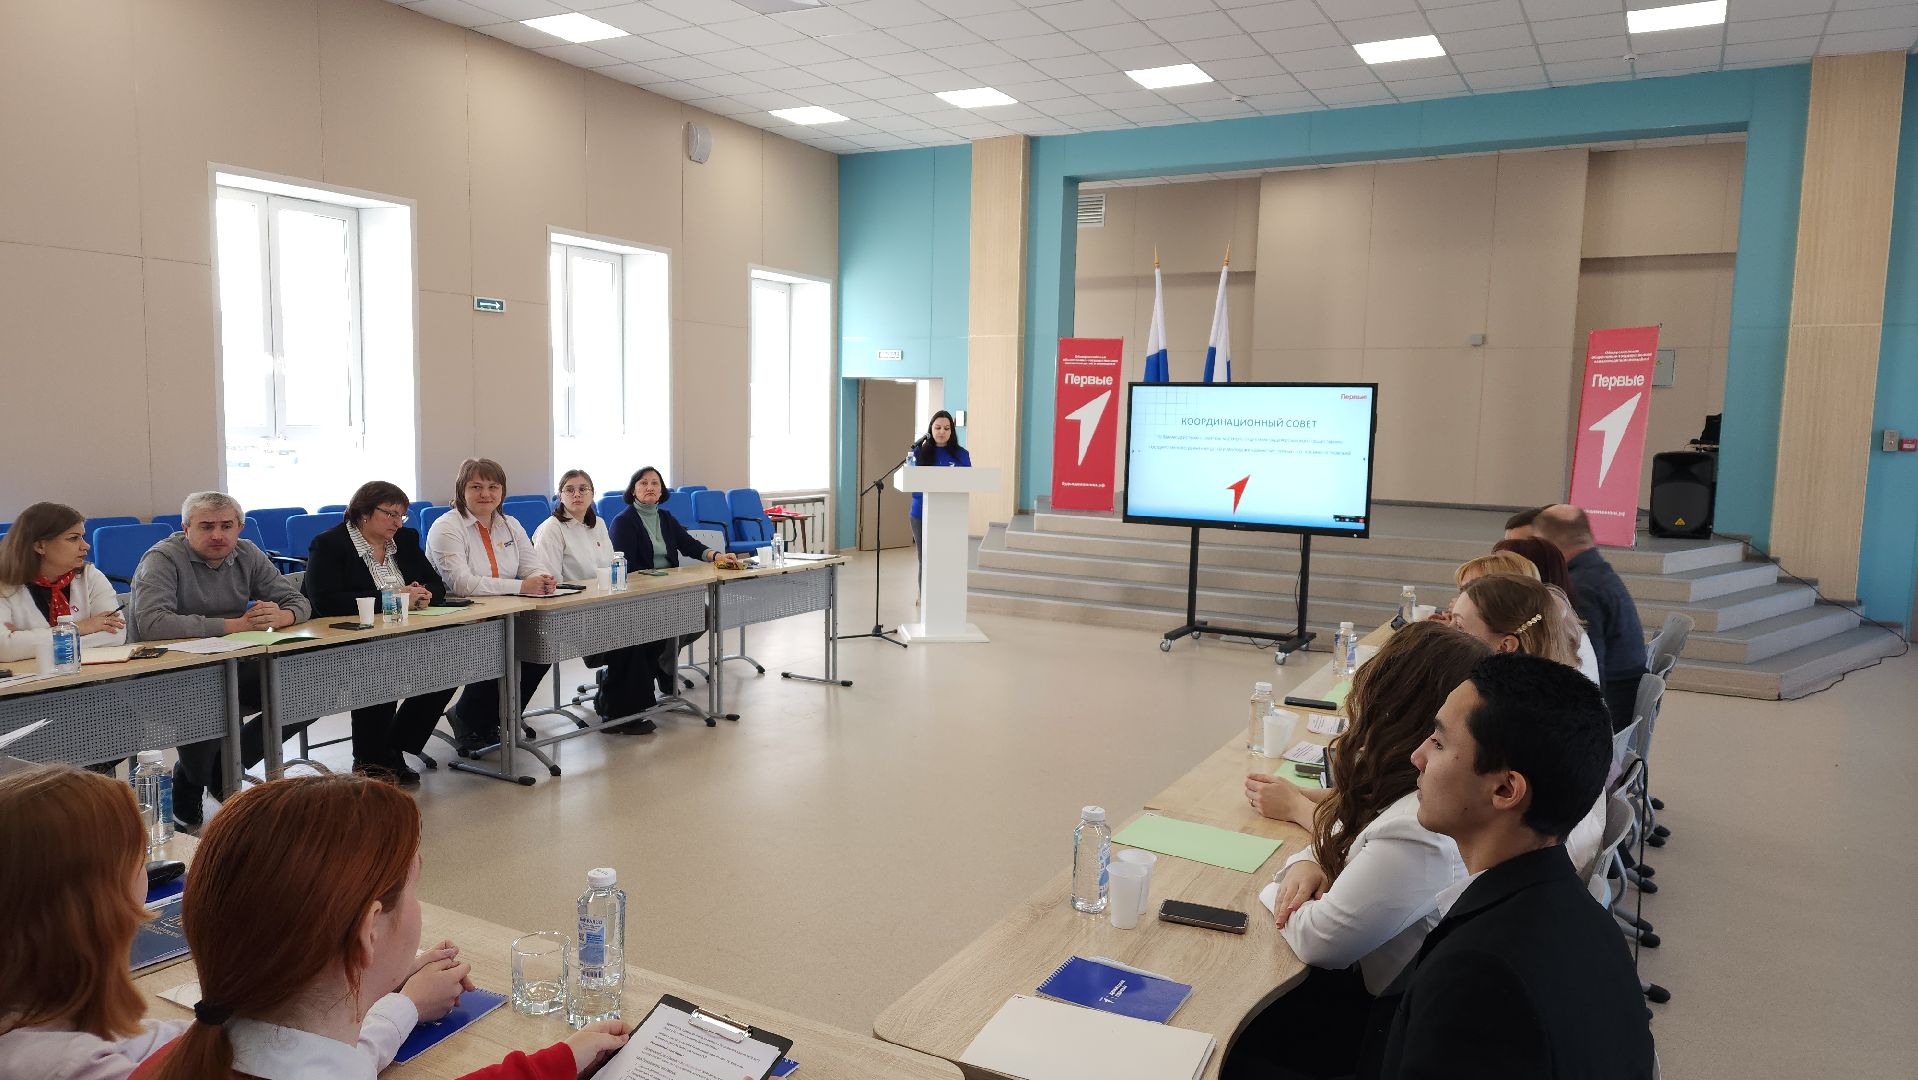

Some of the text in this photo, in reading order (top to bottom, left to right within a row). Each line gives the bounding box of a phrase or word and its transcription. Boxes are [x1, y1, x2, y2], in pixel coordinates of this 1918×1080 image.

[1064, 373, 1113, 387] Первые
[1591, 374, 1645, 390] Первые
[1181, 416, 1317, 429] КООРДИНАЦИОННЫЙ СОВЕТ
